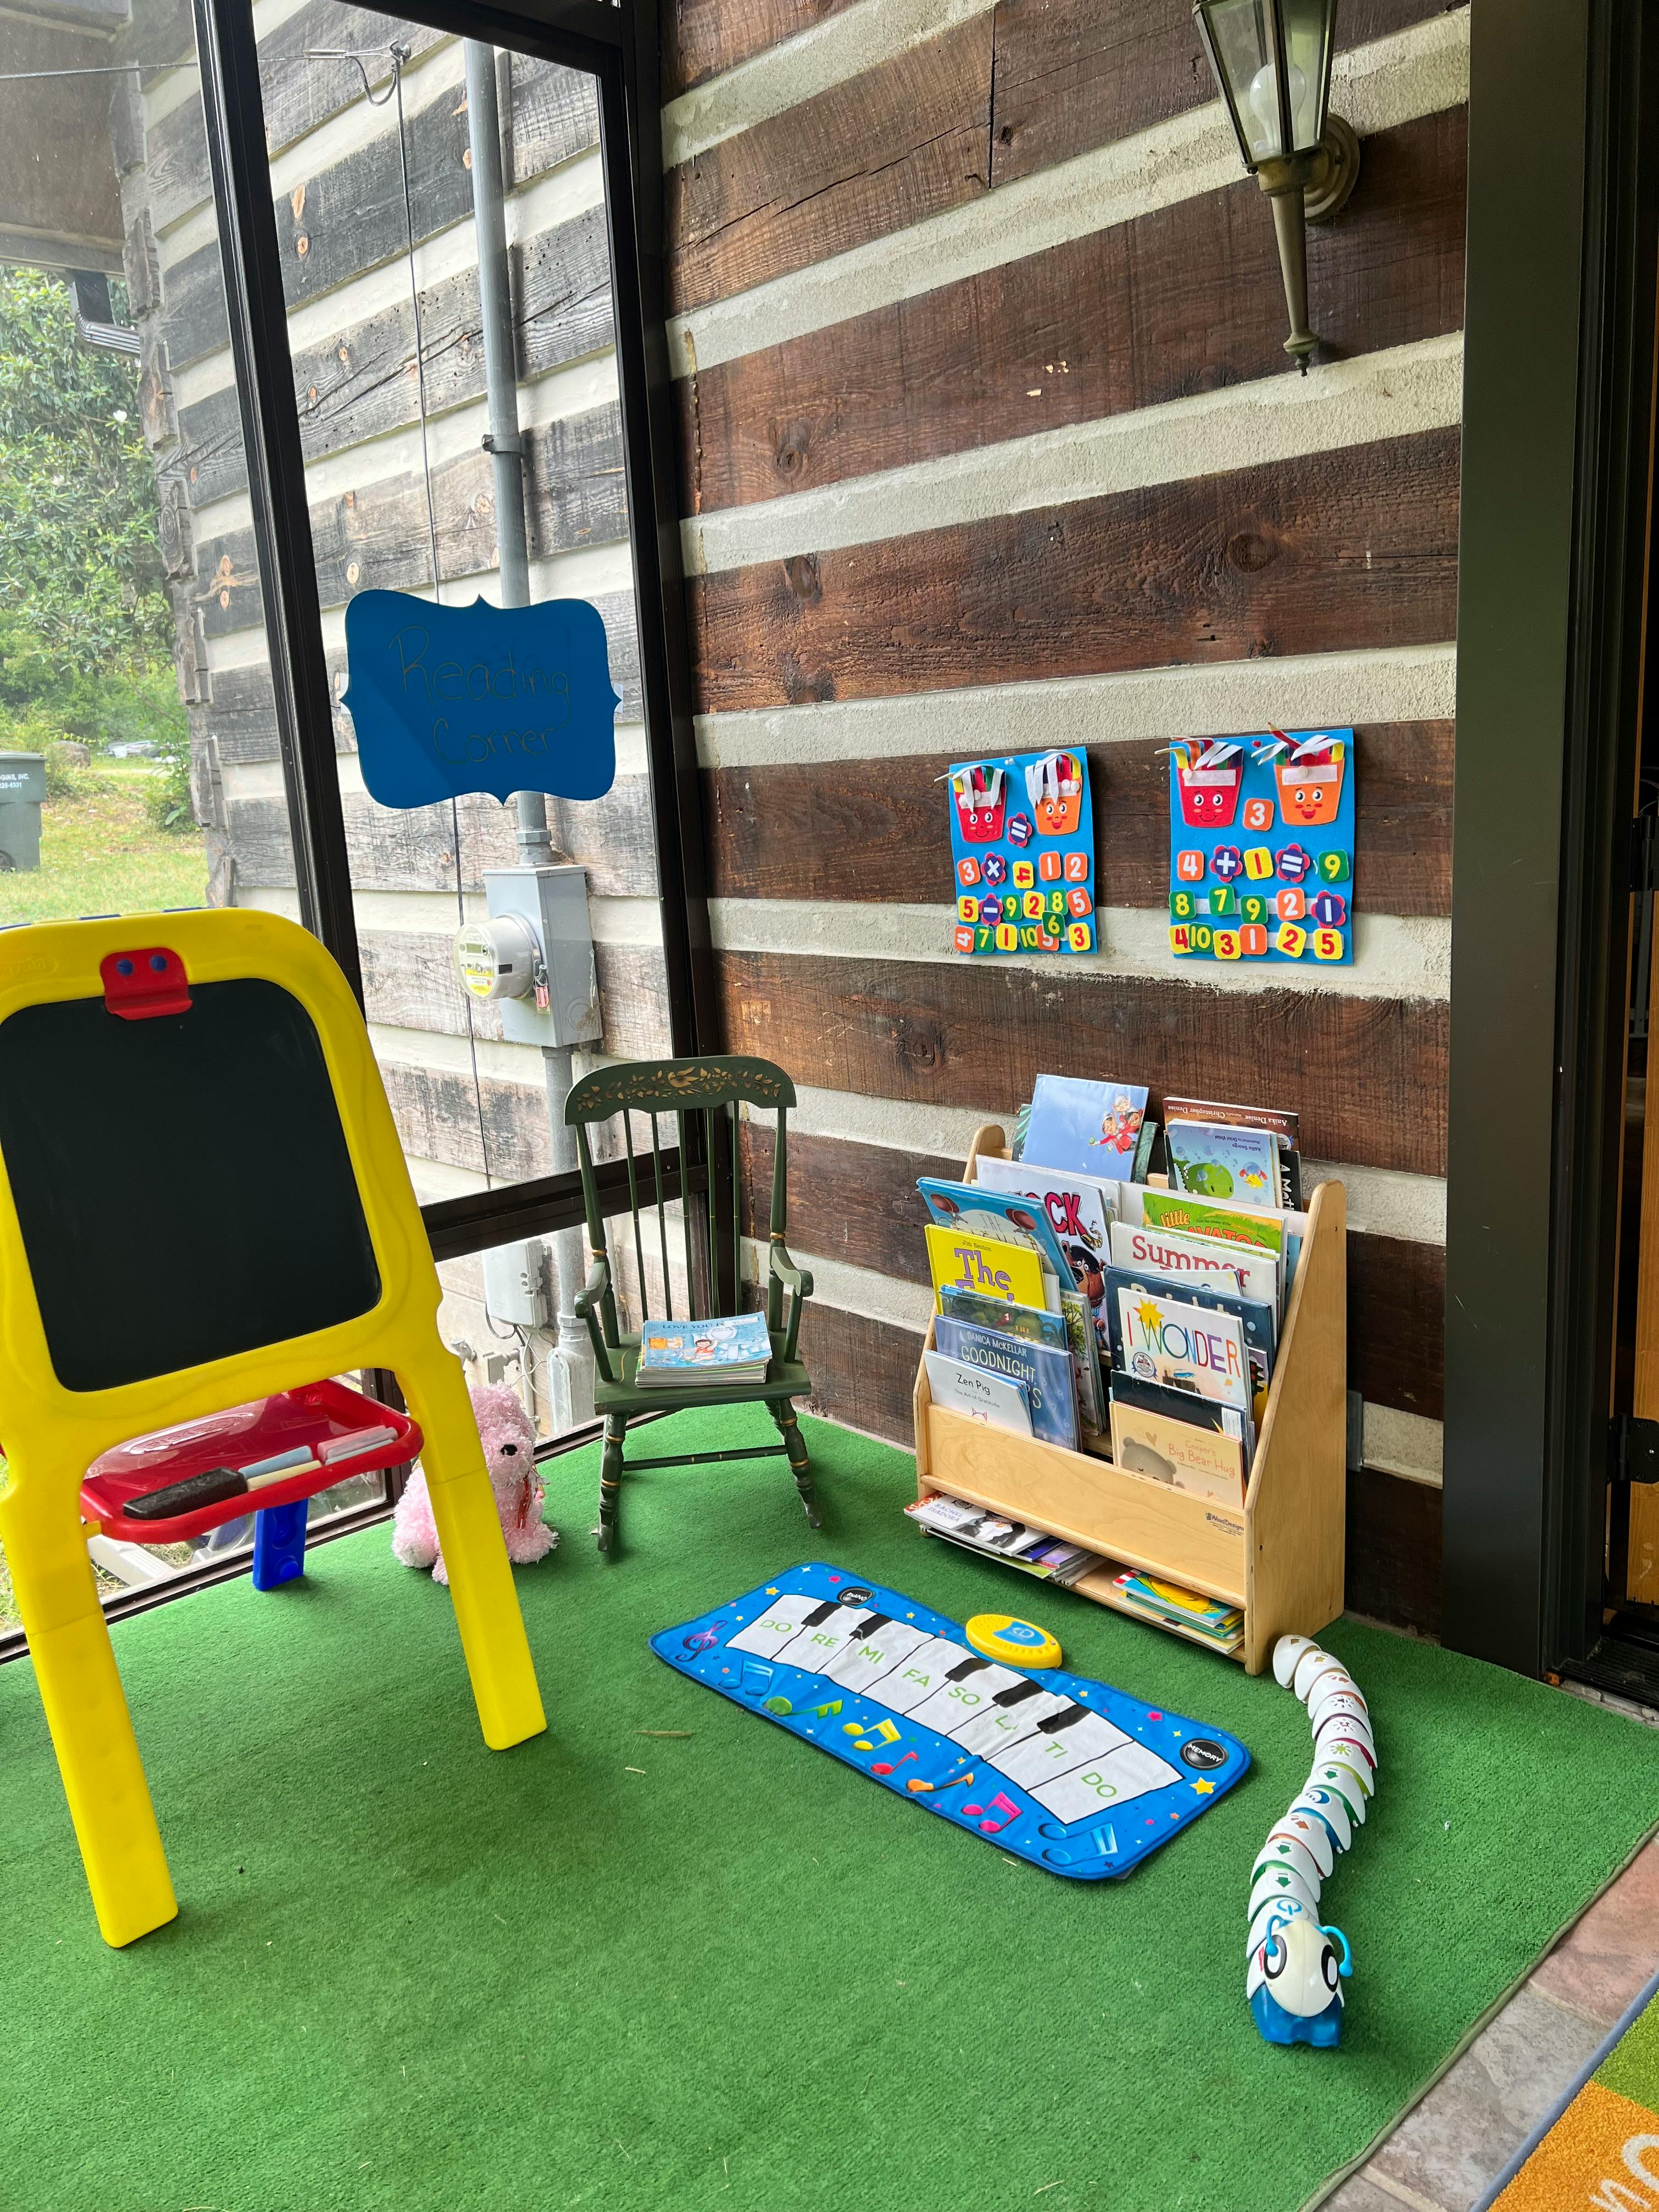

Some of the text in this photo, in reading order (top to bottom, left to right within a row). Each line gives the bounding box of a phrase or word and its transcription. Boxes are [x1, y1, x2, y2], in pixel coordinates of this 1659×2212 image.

[388, 625, 573, 727] Reading
[432, 717, 556, 764] Corner
[1250, 803, 1266, 826] 3
[963, 862, 974, 876] 3
[1047, 856, 1052, 871] 1
[1070, 857, 1081, 877] 2
[1183, 854, 1198, 877] 4
[1254, 853, 1262, 874] 1
[1324, 854, 1341, 879] 9
[964, 900, 973, 918] 5
[1006, 897, 1015, 916] 9
[1030, 896, 1039, 915] 2
[1052, 894, 1063, 911] 8
[1073, 892, 1085, 912] 5
[1175, 889, 1299, 921] 8 7 9 2
[979, 930, 989, 947] 7
[1004, 928, 1008, 946] 1
[1020, 927, 1037, 947] 10
[1048, 915, 1060, 934] 6
[1074, 927, 1085, 947] 3
[1175, 926, 1335, 955] 4 10 3 1 2 5
[1167, 1105, 1188, 1114] Denise
[1189, 1108, 1226, 1119] Christopher
[1245, 1115, 1267, 1124] Denise
[1268, 1118, 1288, 1127] Anika
[1280, 1164, 1290, 1172] A
[979, 1214, 1003, 1232] THE
[1160, 1209, 1190, 1227] little
[974, 1242, 992, 1252] Benton
[954, 1248, 1011, 1290] The
[967, 1331, 991, 1347] DANICA
[1015, 1325, 1031, 1334] THE
[1126, 1312, 1241, 1378] I WONDER
[961, 1346, 1037, 1385] GOODNIGHT,
[956, 1373, 990, 1396] Zen Pig
[978, 1397, 1000, 1408] Gratitude
[1186, 1441, 1216, 1457] Cooper's
[1169, 1443, 1184, 1462] Big
[1188, 1450, 1212, 1466] Bear
[1215, 1459, 1236, 1479] Hug
[928, 1507, 960, 1522] ISADORA
[934, 1503, 964, 1517] RACHEL
[847, 1592, 867, 1601] PIANO
[759, 1620, 792, 1633] DO
[810, 1632, 840, 1648] RE
[857, 1645, 885, 1664] MI
[902, 1668, 930, 1688] FA
[948, 1686, 981, 1706] SO
[1045, 1741, 1069, 1759] TI
[1188, 1743, 1222, 1762] MEMORY
[1081, 1771, 1118, 1798] DO
